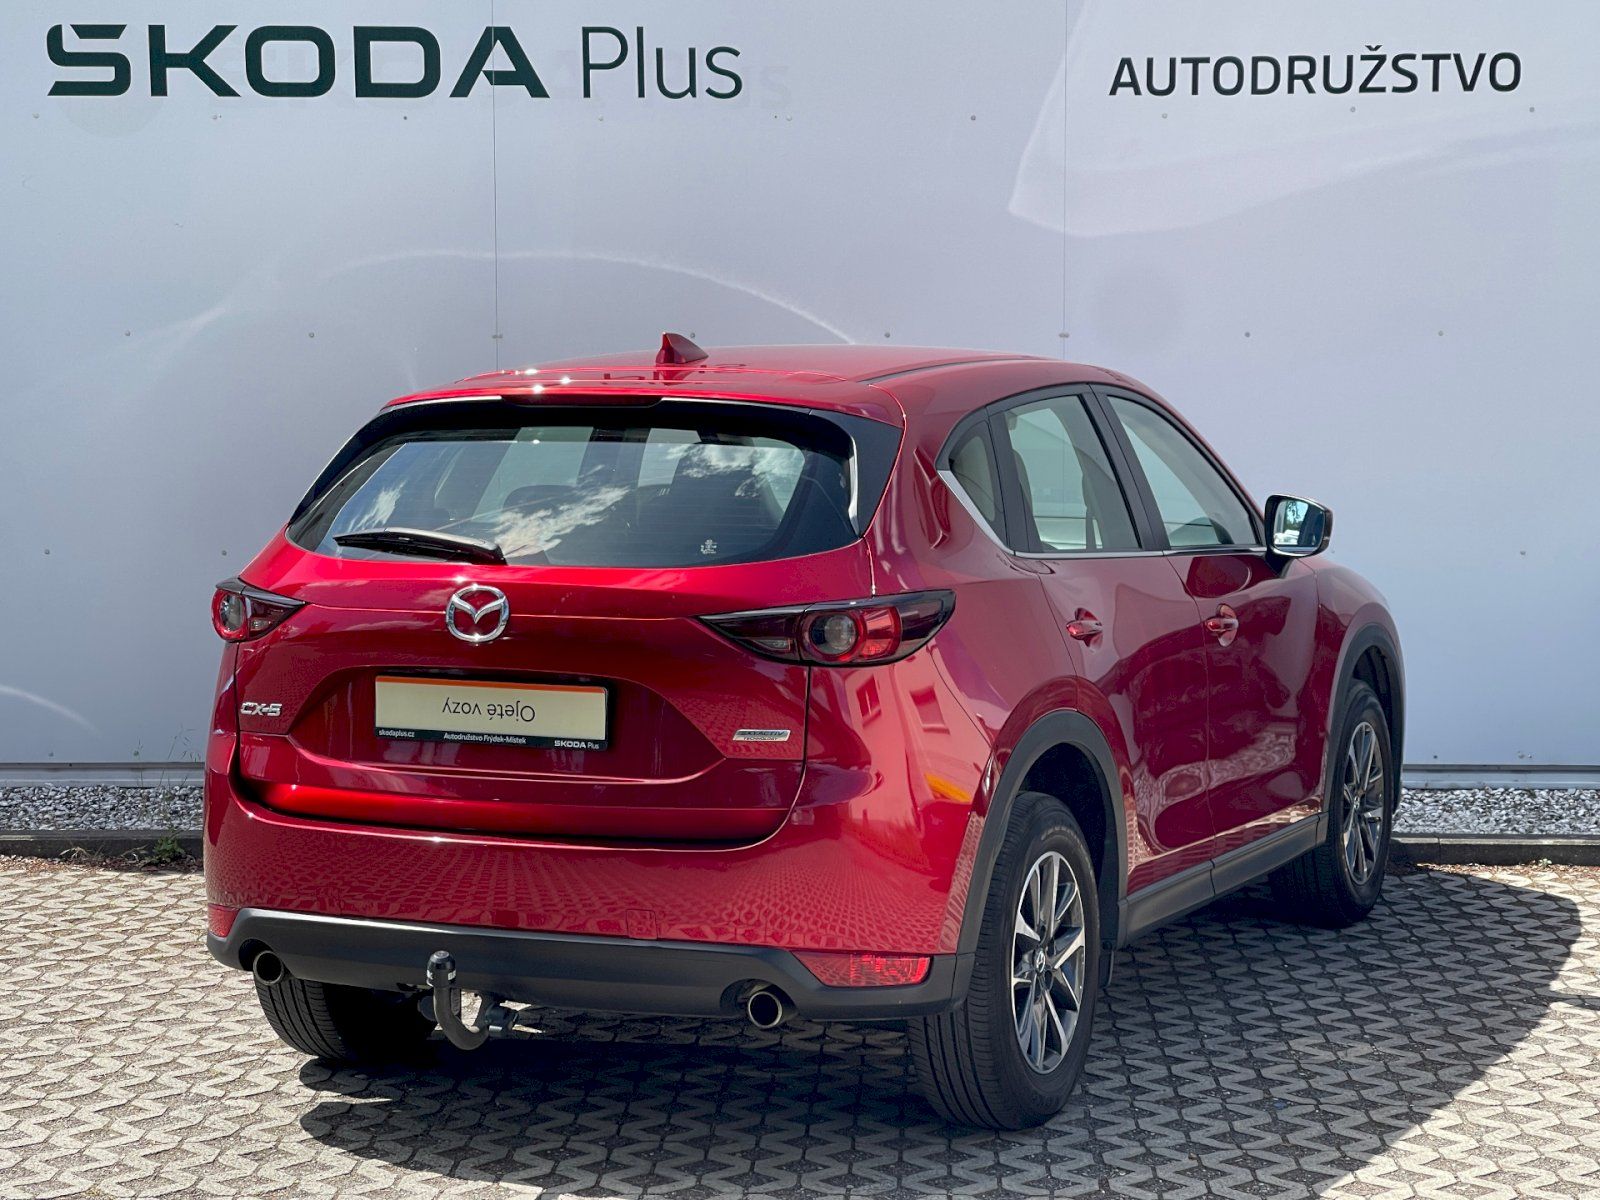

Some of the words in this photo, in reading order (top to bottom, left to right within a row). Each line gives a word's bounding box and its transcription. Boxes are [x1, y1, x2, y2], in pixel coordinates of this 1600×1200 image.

[581, 26, 743, 99] Plus
[1108, 44, 1521, 97] AUTODRUŽSTVO
[240, 701, 283, 717] CX-5
[442, 697, 482, 715] vozy
[487, 700, 536, 722] Ojeté
[587, 742, 600, 750] Plus
